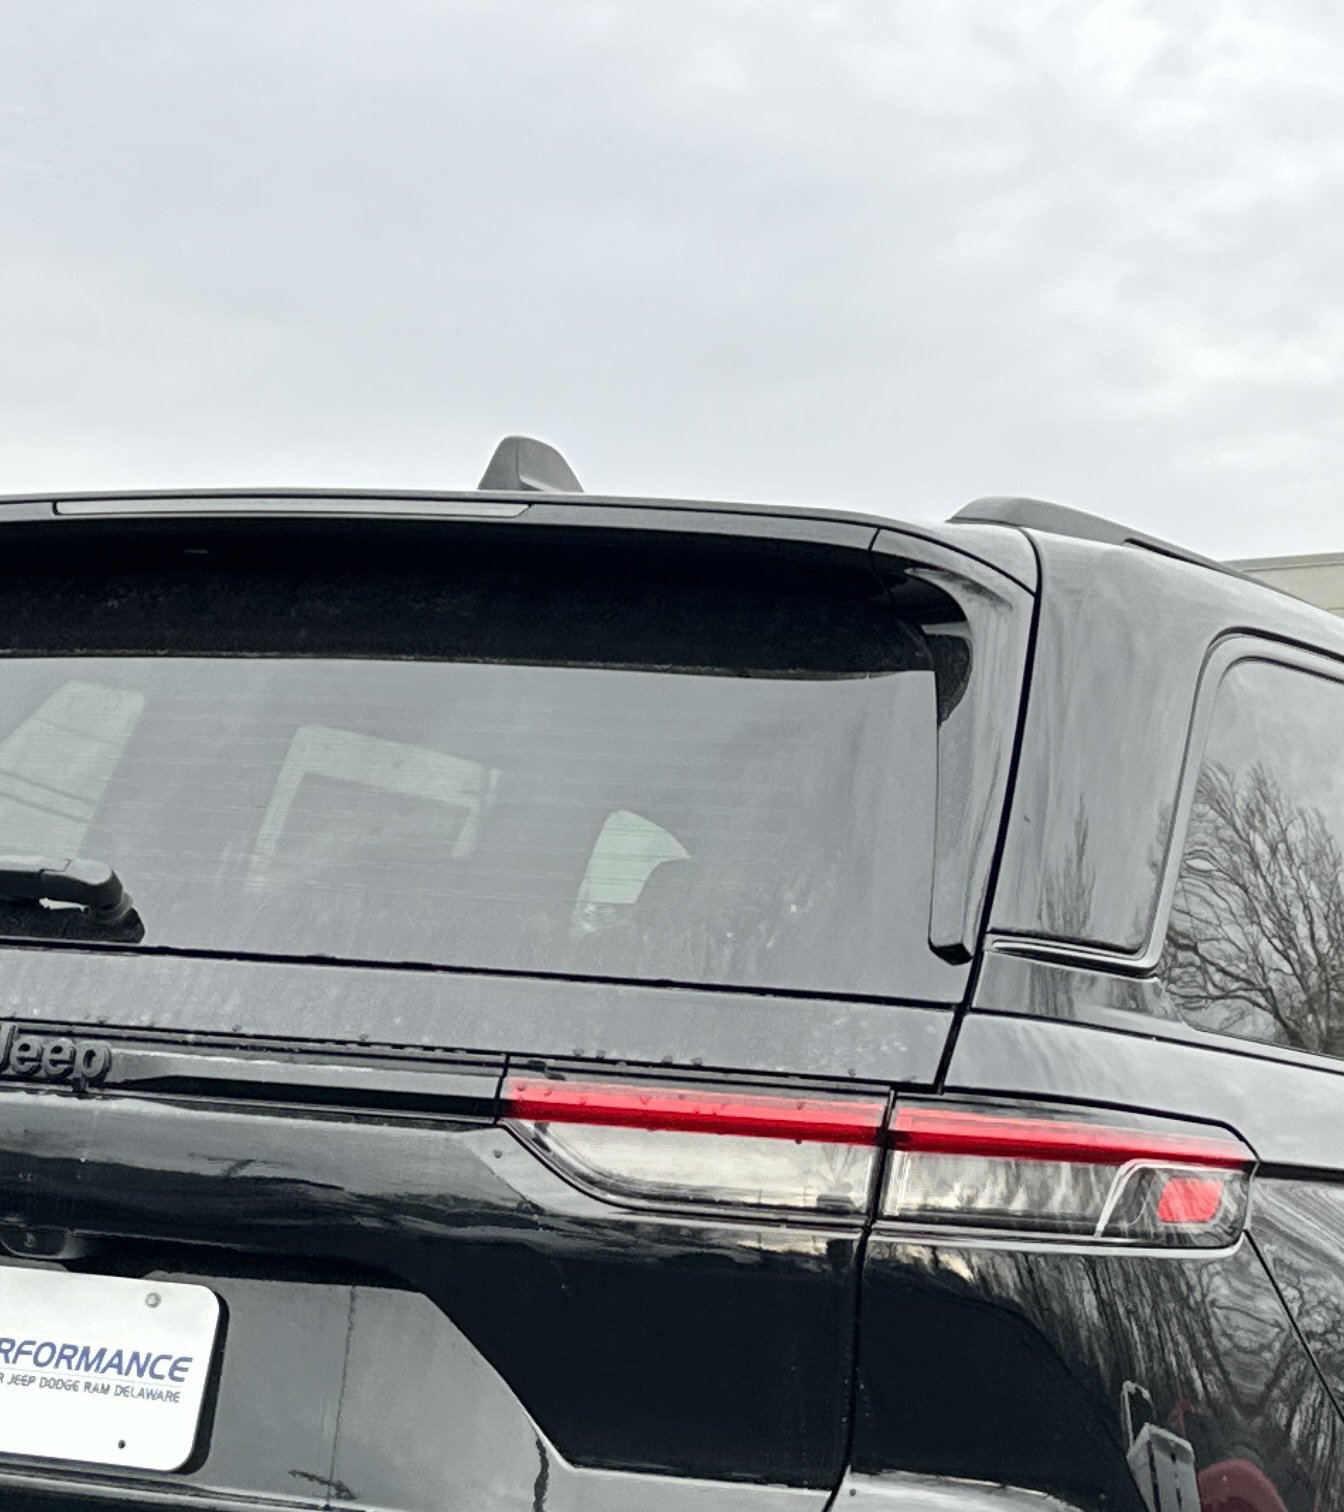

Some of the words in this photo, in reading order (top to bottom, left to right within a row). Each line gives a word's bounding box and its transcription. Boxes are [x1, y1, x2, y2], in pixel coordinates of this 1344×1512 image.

[7, 1373, 36, 1388] JEEP
[39, 1377, 80, 1393] DODGE
[83, 1382, 111, 1396] RAM
[114, 1385, 181, 1404] DELAWARE
